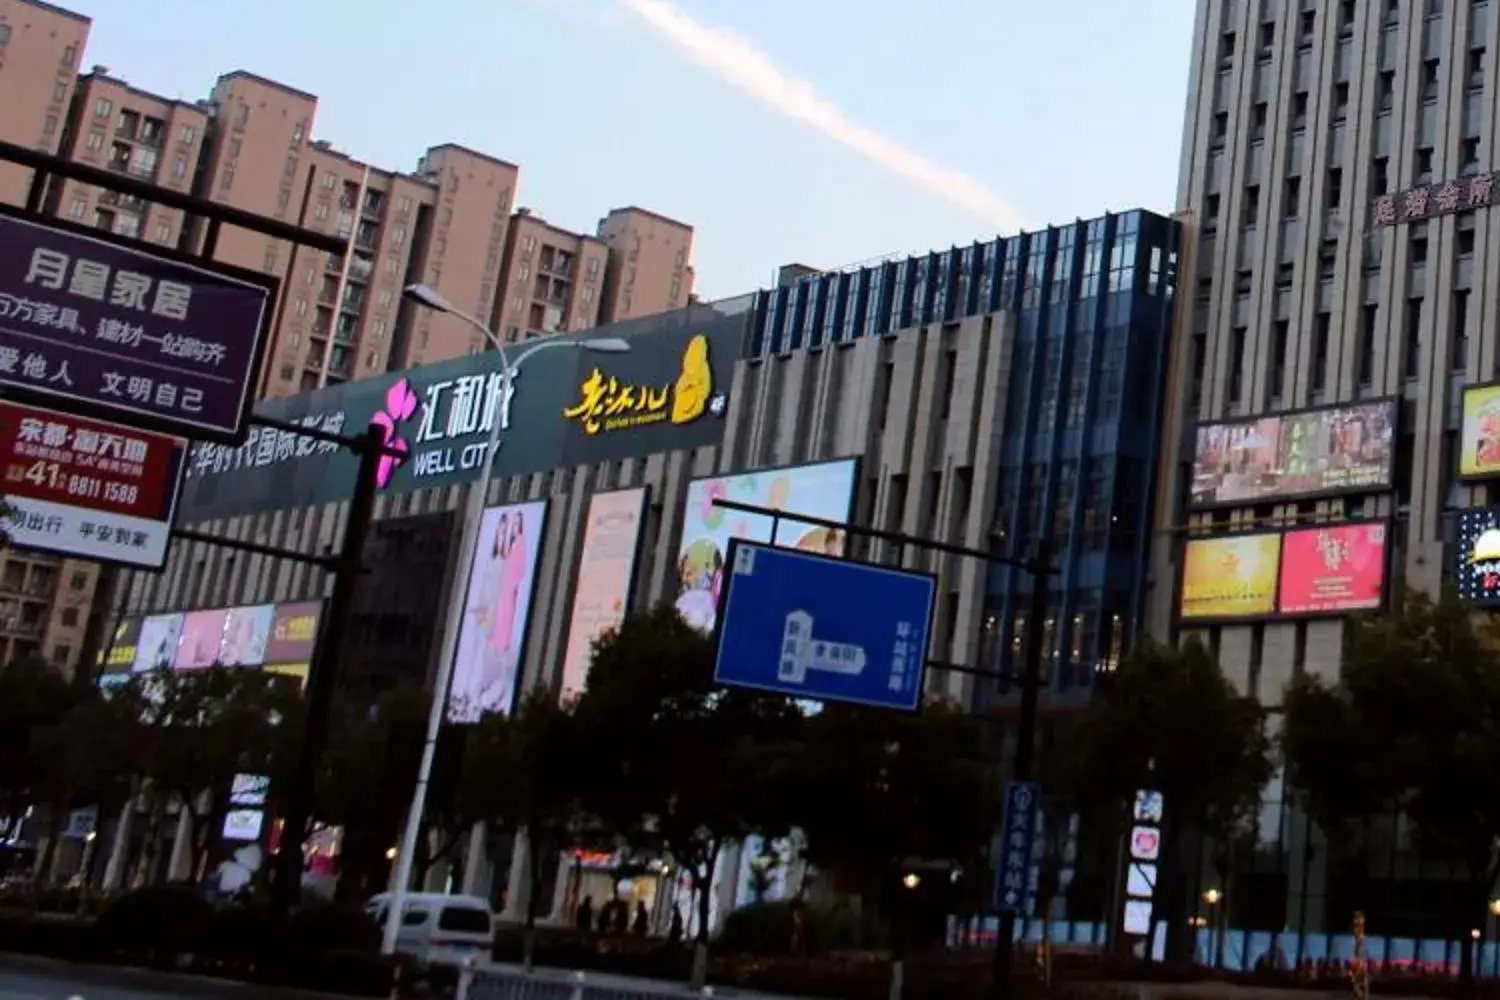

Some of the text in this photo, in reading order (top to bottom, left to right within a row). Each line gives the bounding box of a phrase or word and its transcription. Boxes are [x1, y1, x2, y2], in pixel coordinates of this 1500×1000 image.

[24, 248, 192, 320] 月星家居
[99, 371, 205, 413] 文明自己
[416, 368, 518, 443] 汇和城
[414, 448, 454, 477] WELL
